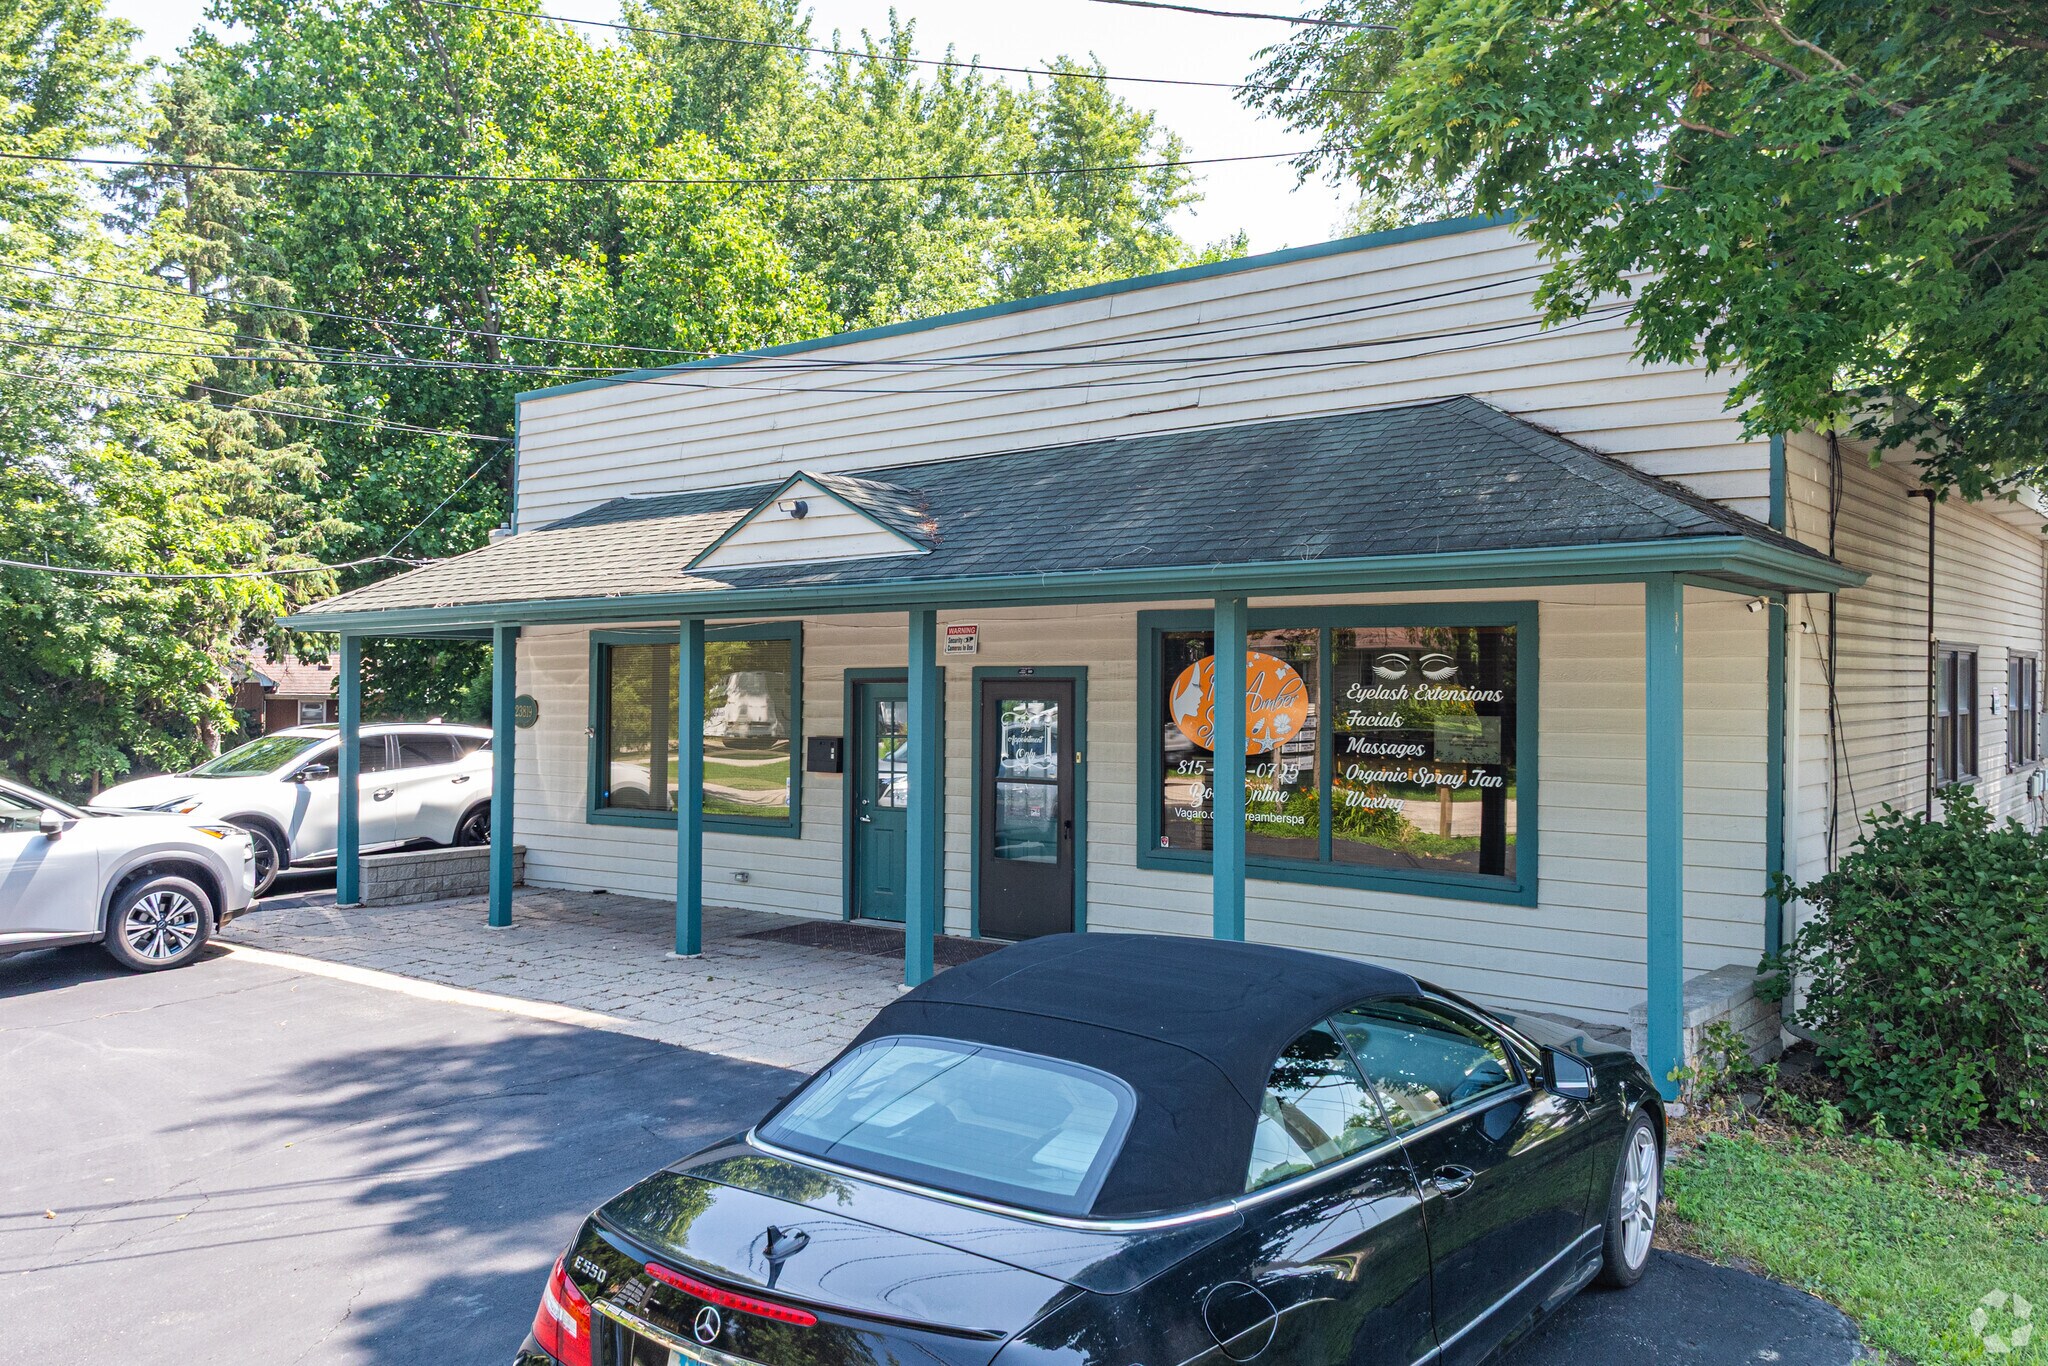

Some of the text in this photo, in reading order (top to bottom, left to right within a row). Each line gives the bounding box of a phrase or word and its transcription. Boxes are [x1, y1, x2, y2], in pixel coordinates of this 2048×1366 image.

[948, 626, 976, 635] WARNING
[948, 636, 963, 644] Security
[1245, 671, 1303, 713] Amber
[1346, 682, 1504, 703] Eyelash Extensions
[1346, 709, 1404, 728] Facials
[1008, 735, 1044, 745] Appointment
[1345, 736, 1426, 758] Massages
[1016, 748, 1036, 764] Only
[1176, 759, 1300, 784] 815--0725
[1345, 763, 1504, 789] Organic Spray Tan
[1345, 789, 1406, 813] Waxing
[574, 1255, 607, 1283] E550
